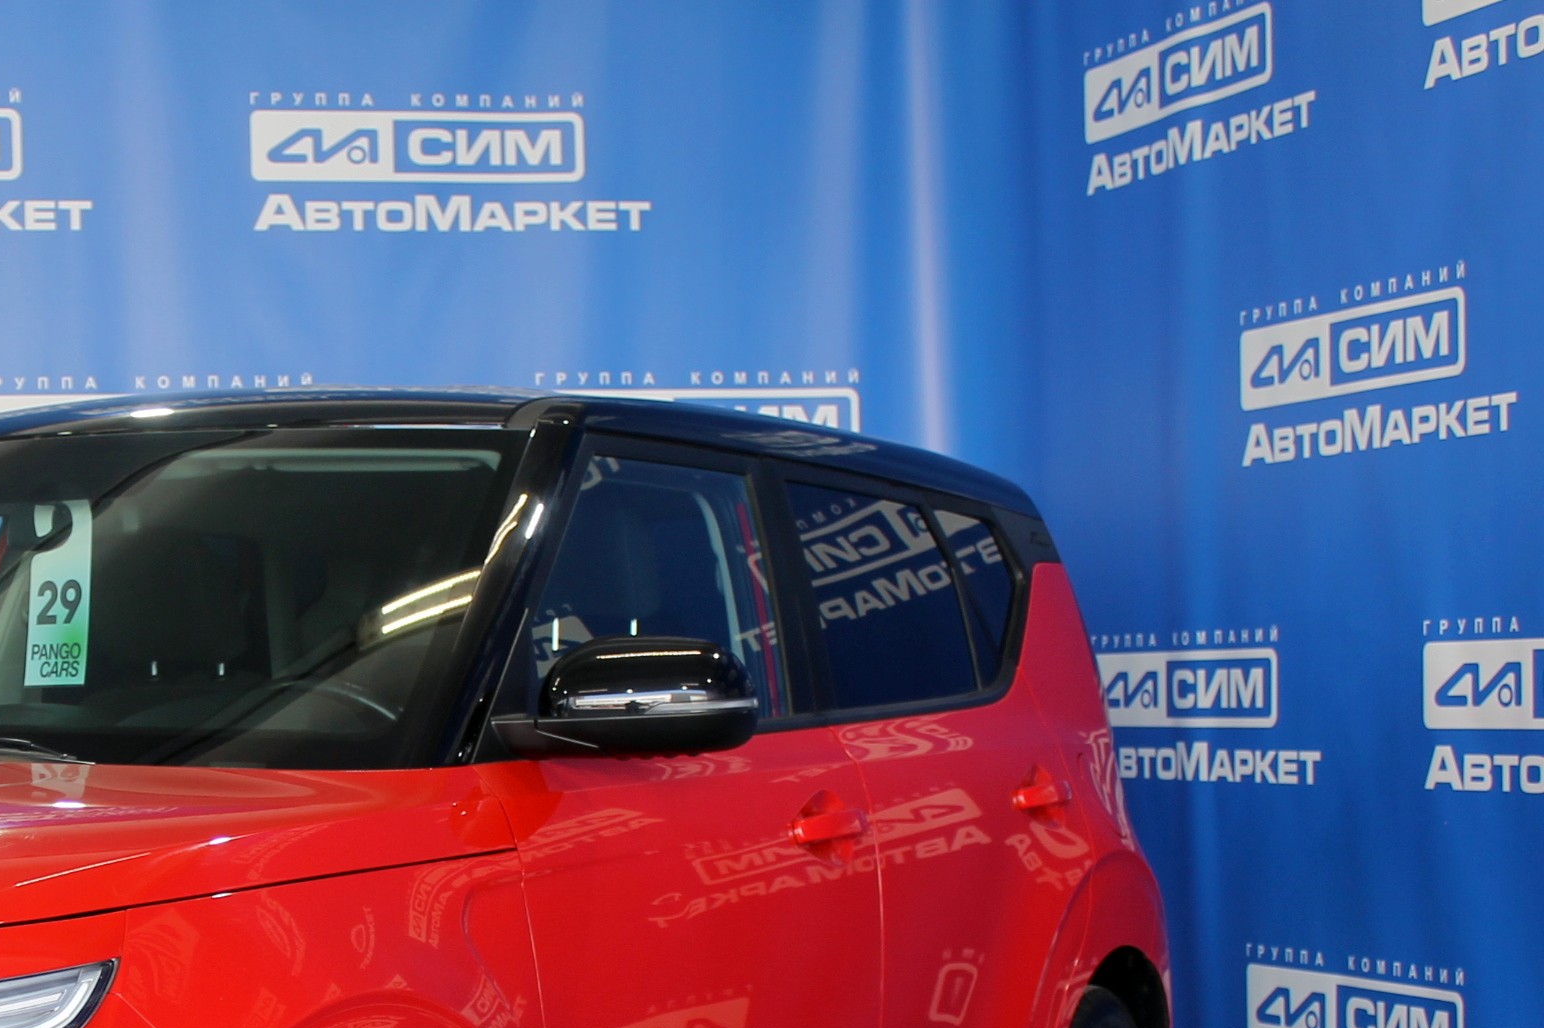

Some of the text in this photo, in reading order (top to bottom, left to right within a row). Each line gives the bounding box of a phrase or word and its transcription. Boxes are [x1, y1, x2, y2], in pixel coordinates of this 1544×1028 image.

[1164, 25, 1259, 96] СИМ
[249, 92, 584, 109] ГРУППА КОМПАНИЙ
[407, 129, 562, 167] СИМ
[1240, 260, 1466, 326] ГРУППА КОМПАНИЙ
[1339, 311, 1449, 373] СИМ
[535, 370, 859, 386] ГРУППА КОМПАНИЙ
[36, 579, 82, 625] 29
[1423, 616, 1520, 636] ГРУППА
[31, 643, 81, 661] PANGO
[39, 661, 80, 678] CARS
[1172, 667, 1263, 710] СИМ
[1246, 943, 1465, 986] ГРУППА КОМПАНИЙ
